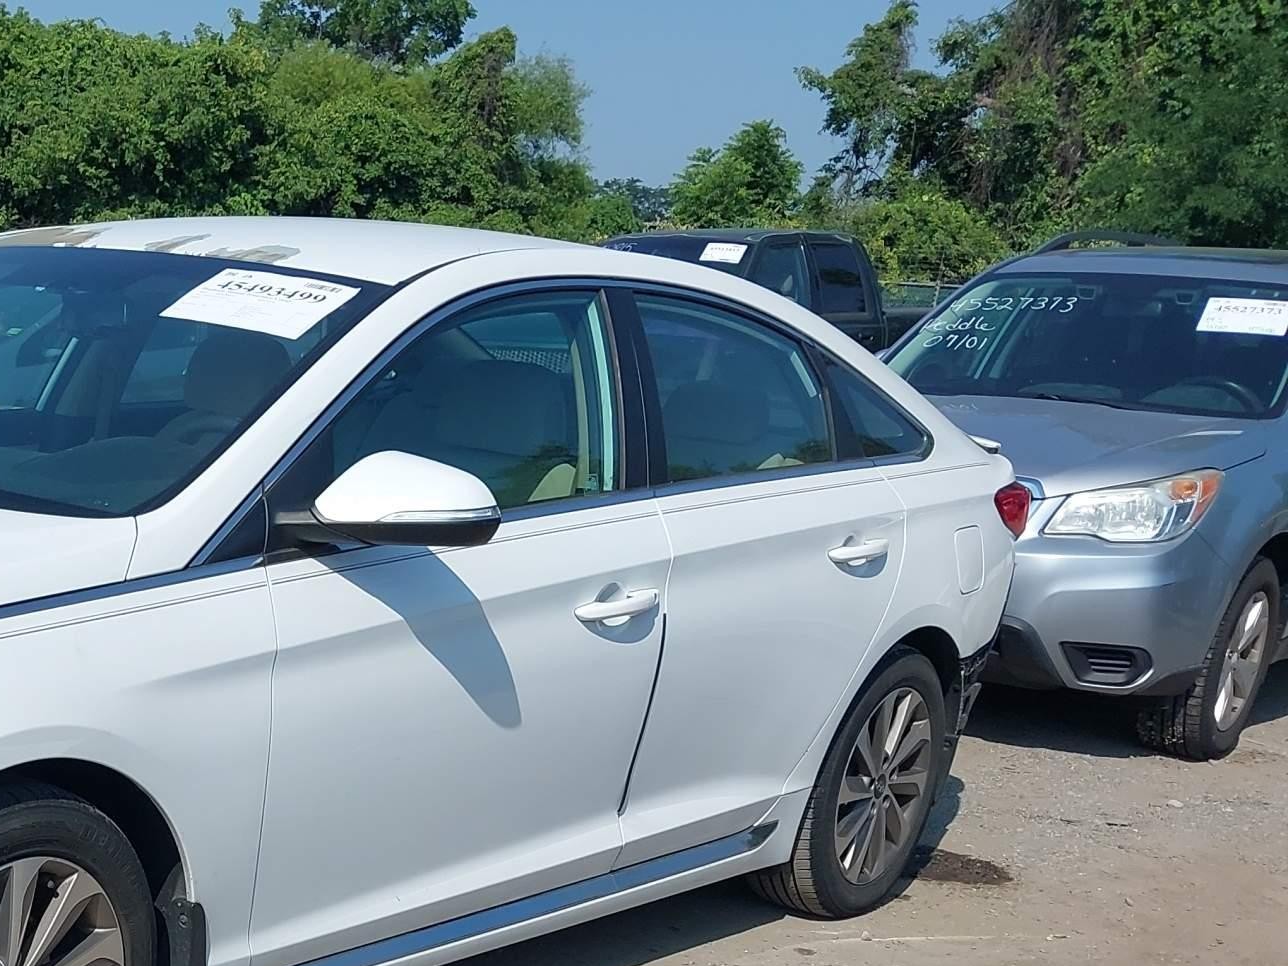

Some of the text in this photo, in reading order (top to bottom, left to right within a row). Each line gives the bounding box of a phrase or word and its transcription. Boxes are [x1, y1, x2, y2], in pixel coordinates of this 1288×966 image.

[217, 281, 327, 303] 45493499
[950, 296, 1078, 313] 45527373
[1214, 305, 1283, 316] 45527373
[923, 334, 988, 350] 07/01
